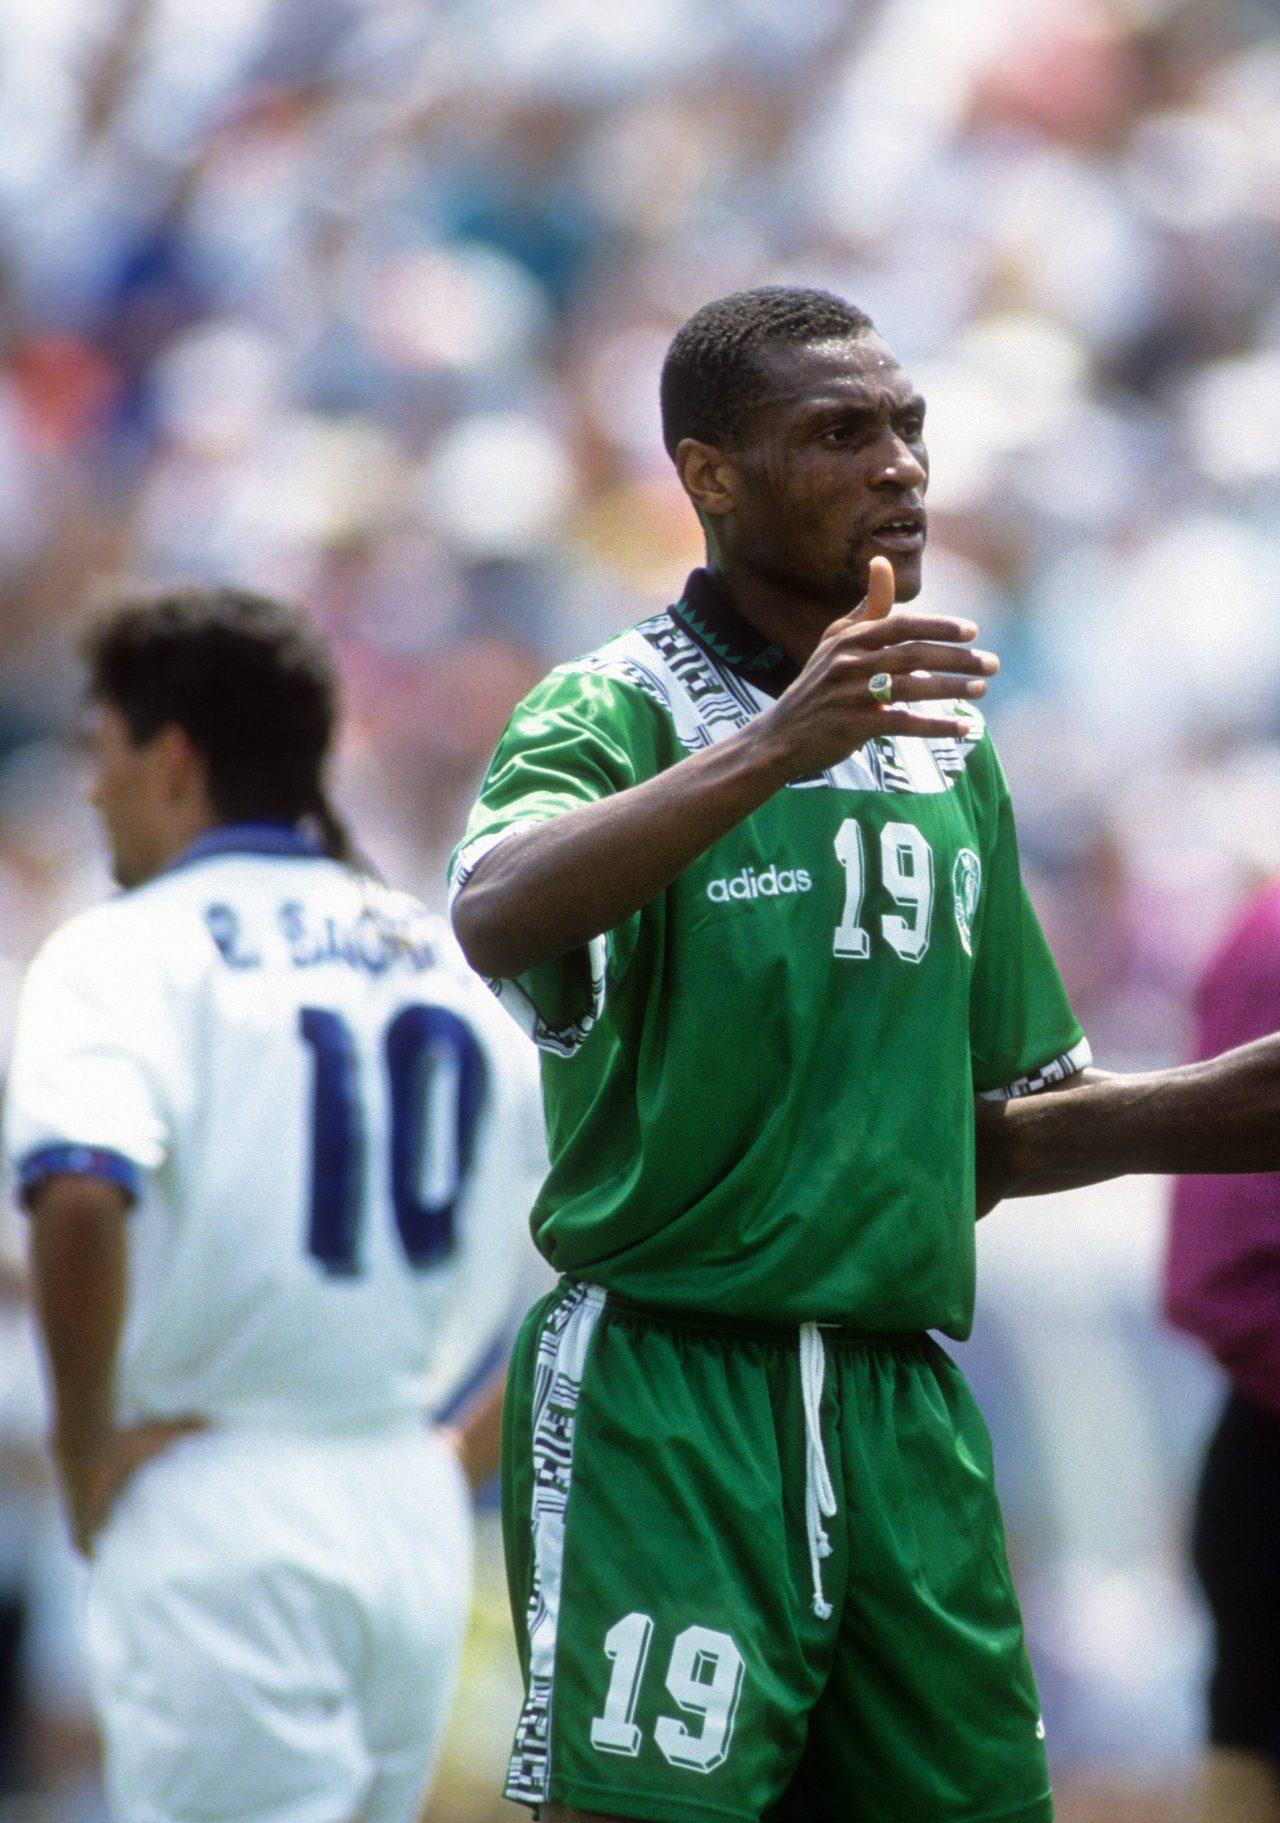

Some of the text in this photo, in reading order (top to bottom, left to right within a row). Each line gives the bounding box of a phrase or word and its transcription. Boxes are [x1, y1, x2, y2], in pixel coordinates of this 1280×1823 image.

[706, 863, 813, 903] adidas
[833, 817, 935, 964] 19
[300, 1004, 491, 1277] 10
[590, 1612, 746, 1775] 19
